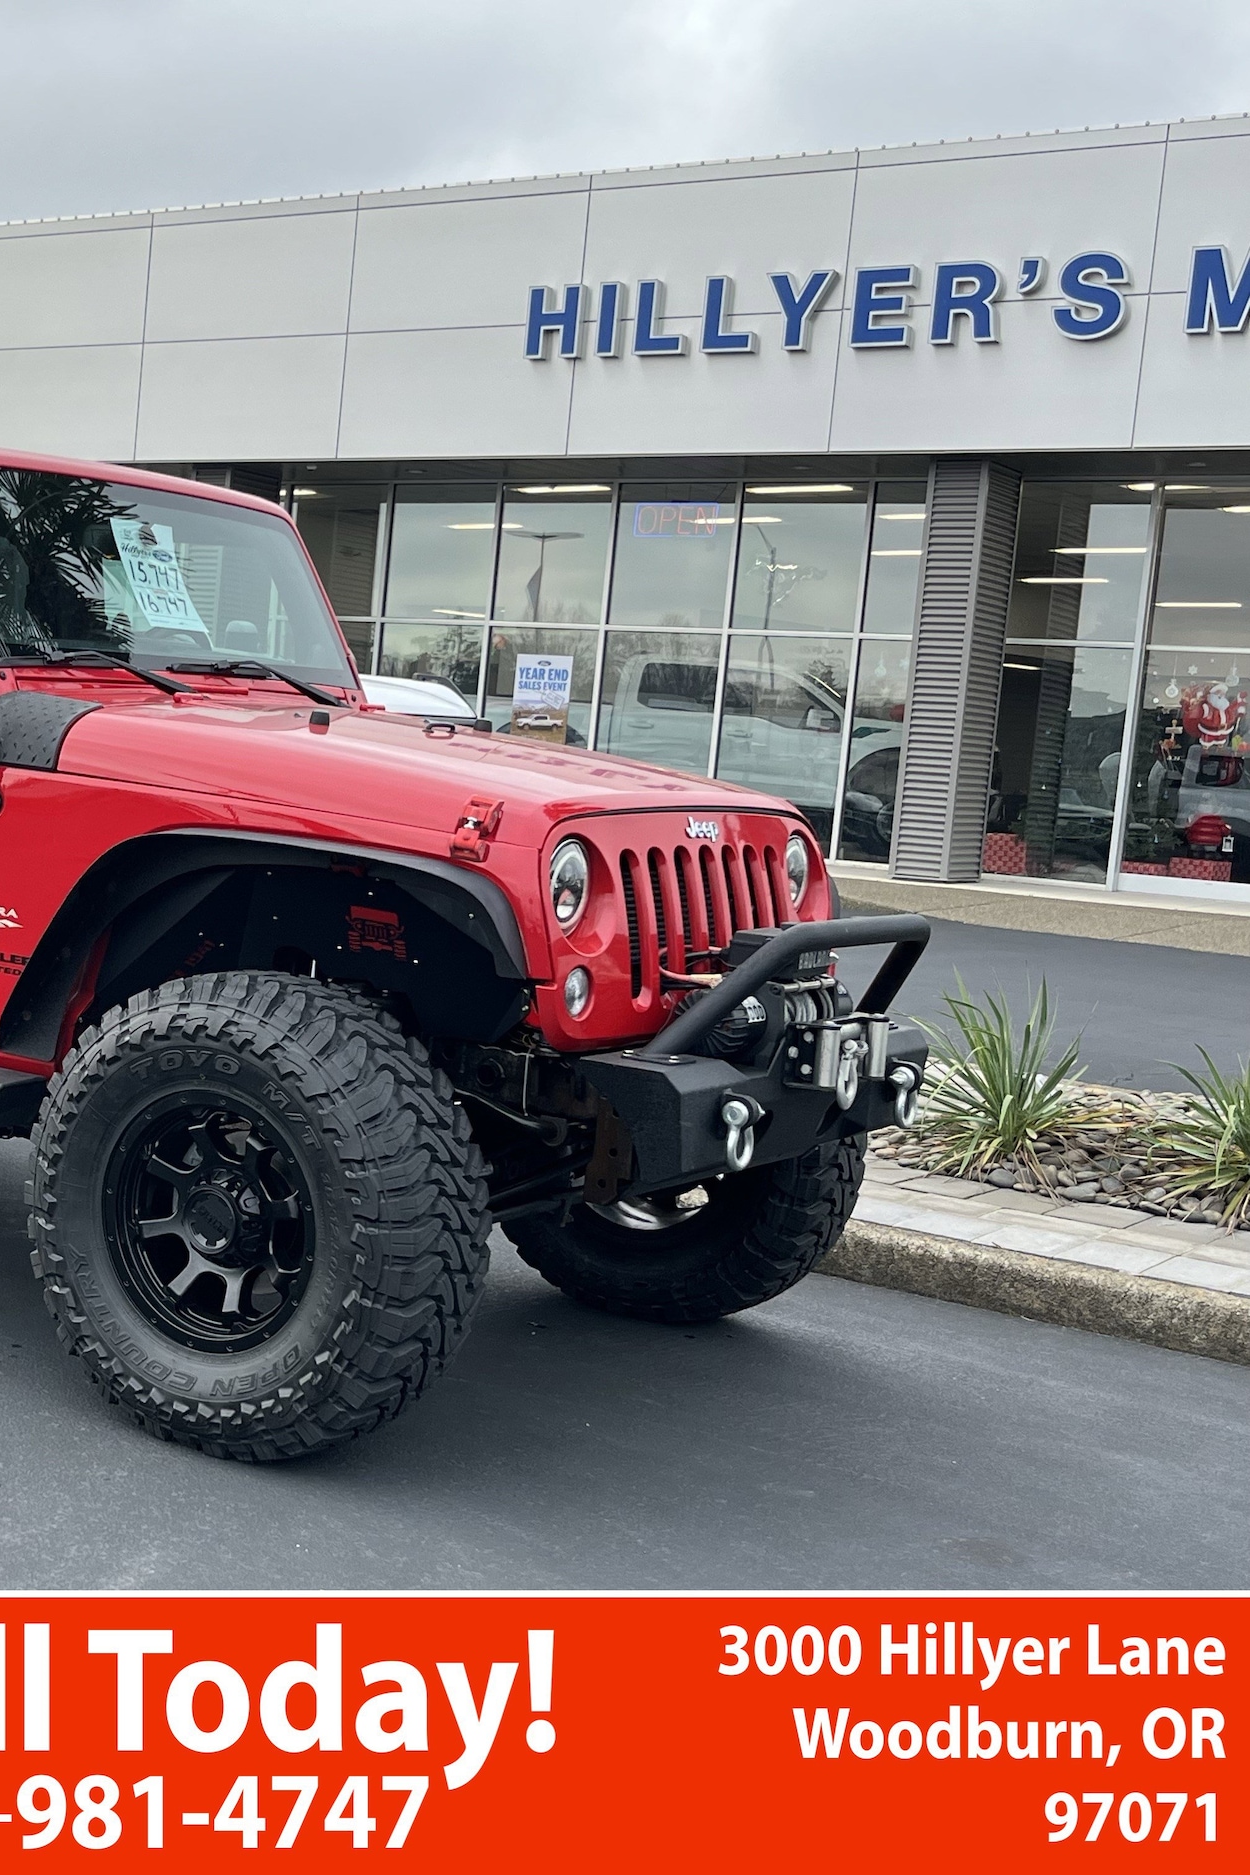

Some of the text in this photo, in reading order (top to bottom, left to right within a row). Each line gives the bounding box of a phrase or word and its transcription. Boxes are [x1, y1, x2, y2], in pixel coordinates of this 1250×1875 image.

[524, 250, 1132, 360] HILLYER'S
[637, 505, 717, 534] OPEN
[518, 667, 569, 681] YEAR END
[518, 681, 568, 691] SALES EVENT
[684, 815, 719, 843] Jeep
[129, 1048, 242, 1081] TOYO
[67, 1242, 199, 1393] COUNTRY
[208, 1342, 302, 1397] OPEN
